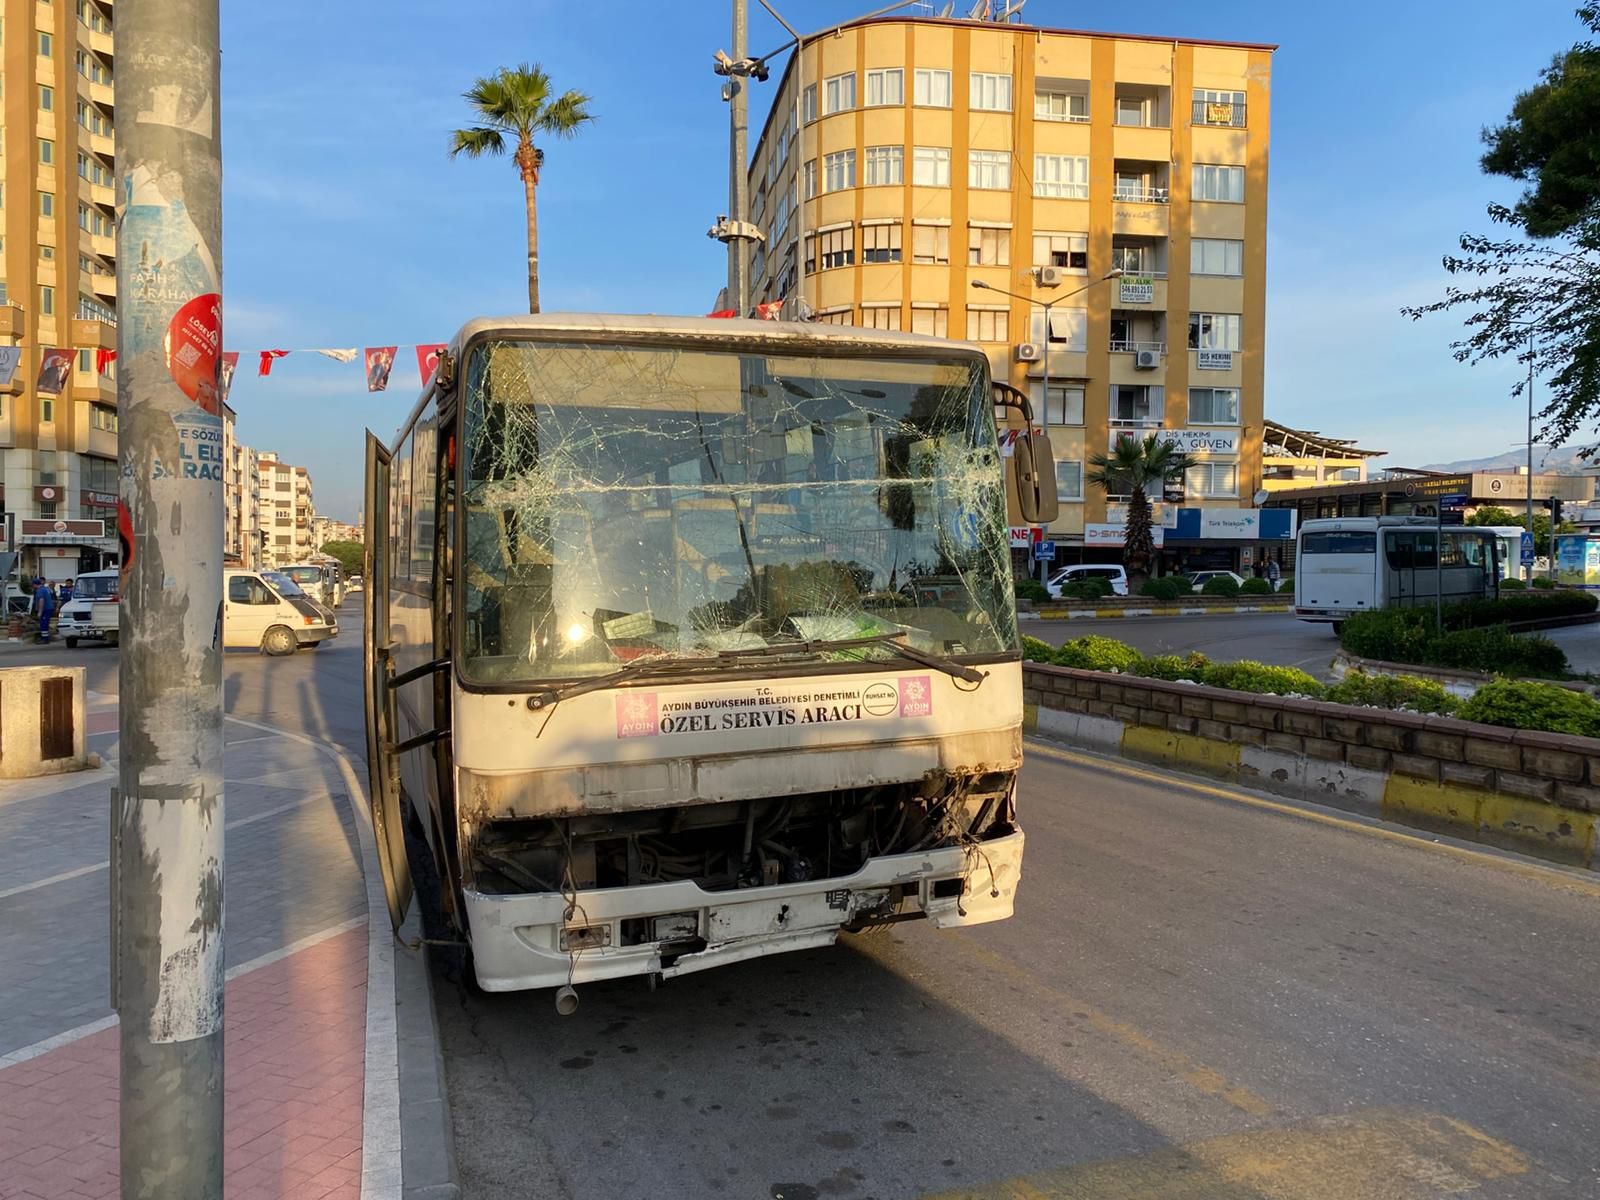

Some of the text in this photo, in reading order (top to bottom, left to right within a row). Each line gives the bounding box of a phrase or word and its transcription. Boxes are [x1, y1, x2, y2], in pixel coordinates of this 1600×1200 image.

[1190, 437, 1233, 449] GÜVEN
[756, 687, 773, 696] T.C.
[662, 702, 692, 712] AYDIN
[695, 696, 756, 711] BÜYÜKŞEHİR
[814, 688, 860, 702] DENETİMLİ
[903, 702, 929, 714] AYDIN
[660, 704, 861, 734] ÖZEL SERVİS ARACI
[622, 721, 655, 736] AYDIN
